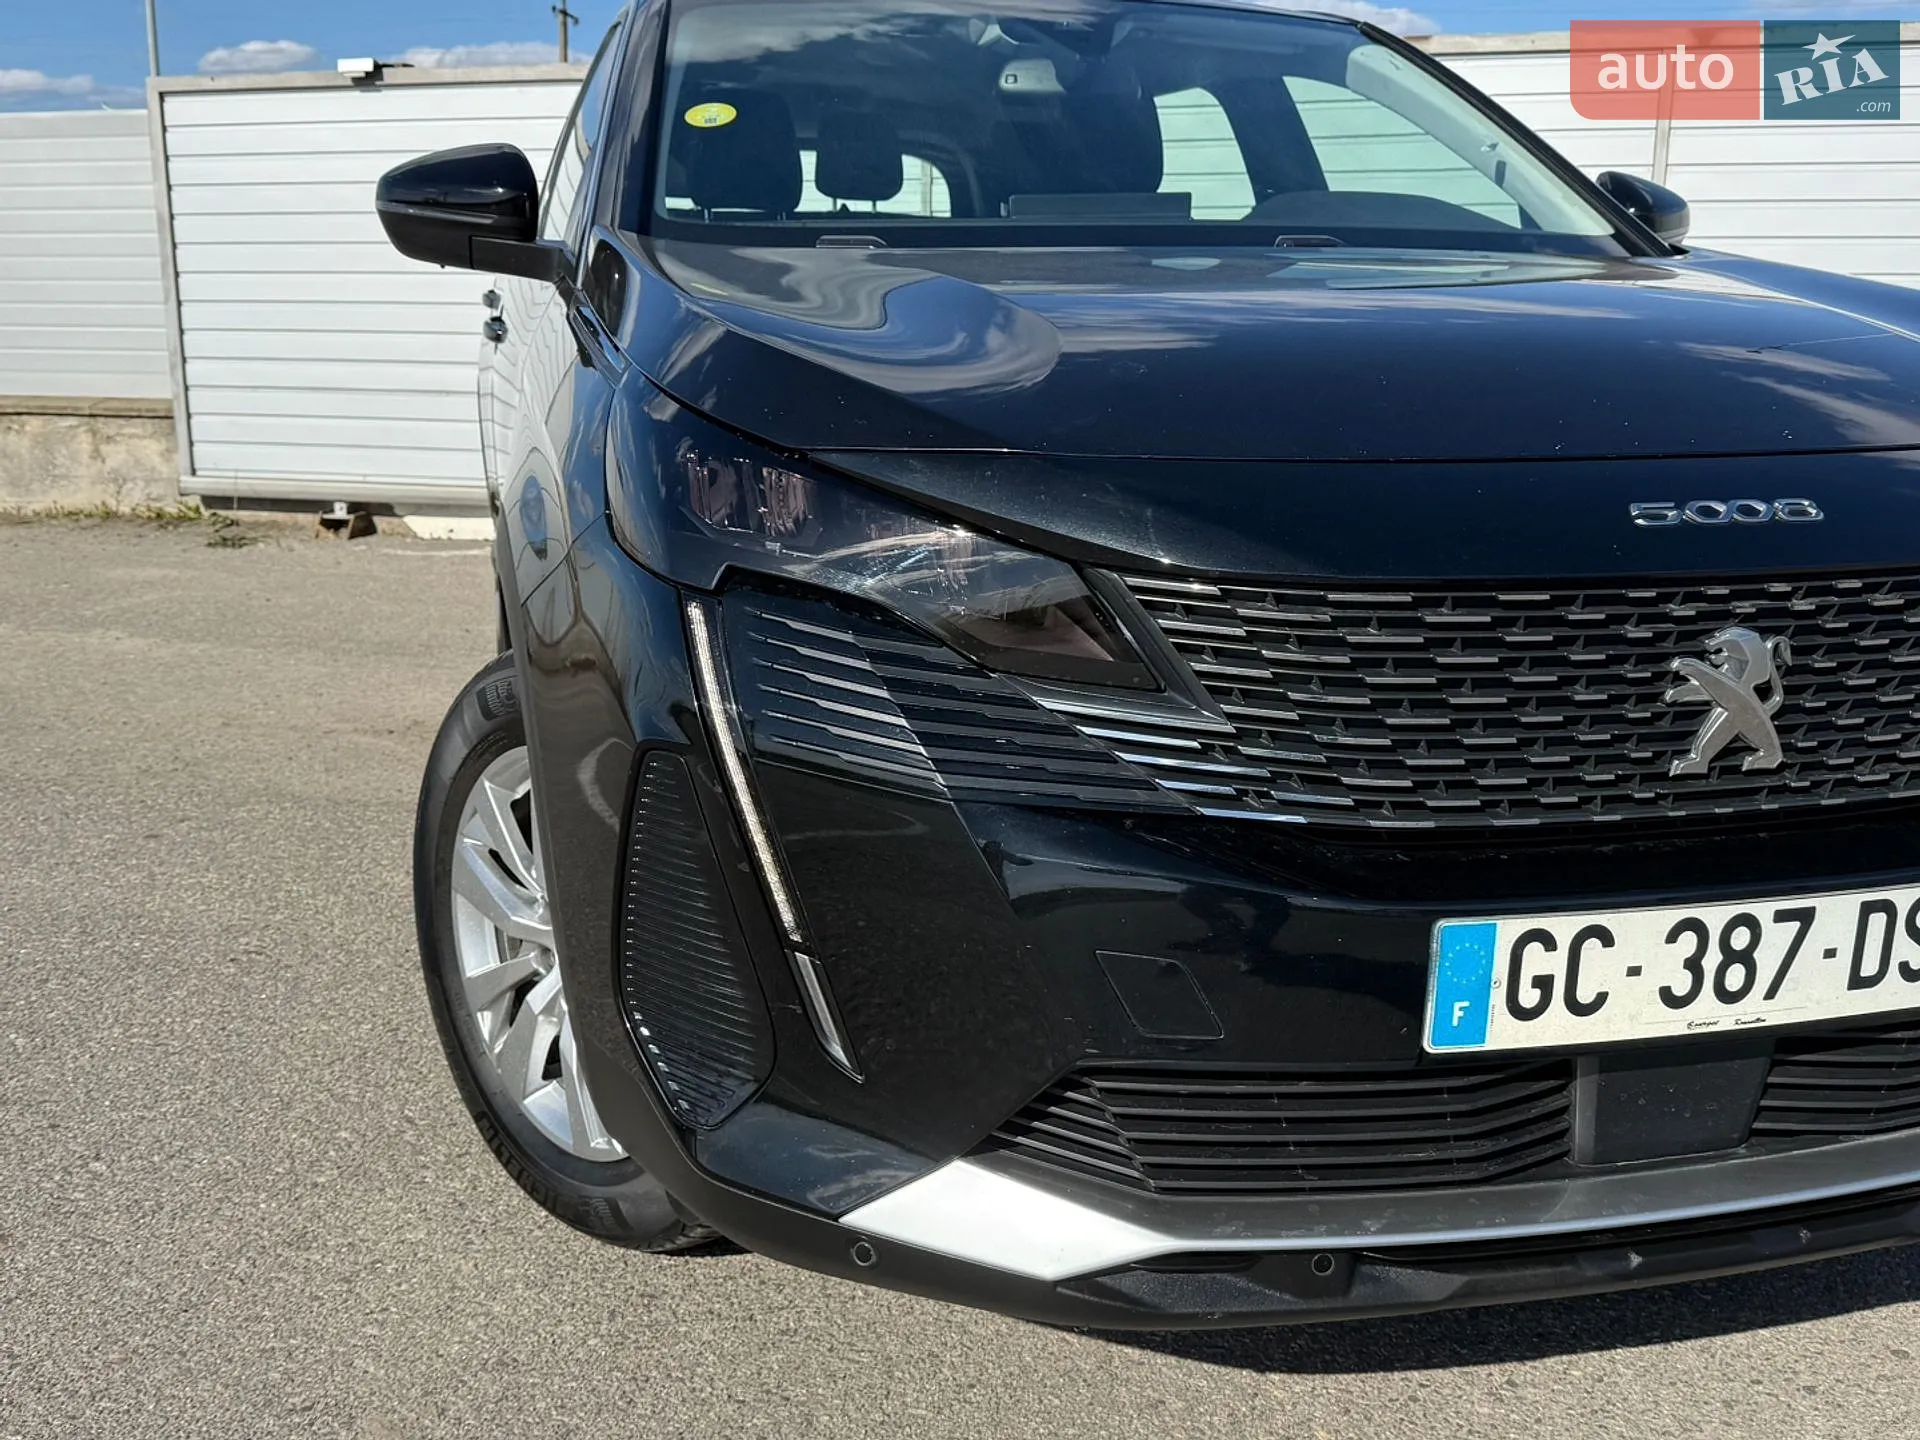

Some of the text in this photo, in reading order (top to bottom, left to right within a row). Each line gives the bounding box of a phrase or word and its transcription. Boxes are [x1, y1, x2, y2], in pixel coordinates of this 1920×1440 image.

[1629, 498, 1825, 527] 5008
[1451, 1001, 1471, 1027] F
[474, 1113, 577, 1222] ICHELIN
